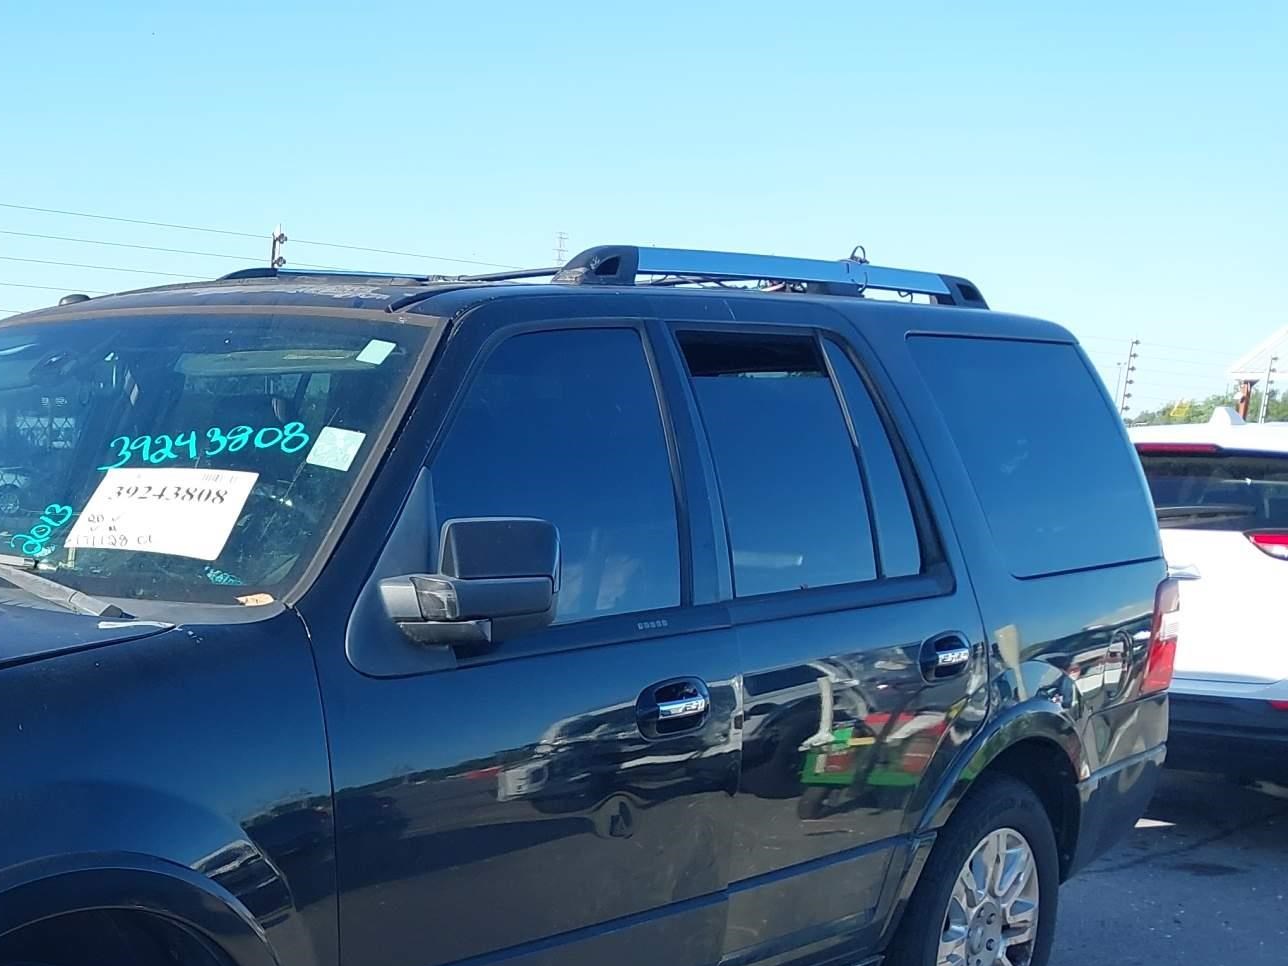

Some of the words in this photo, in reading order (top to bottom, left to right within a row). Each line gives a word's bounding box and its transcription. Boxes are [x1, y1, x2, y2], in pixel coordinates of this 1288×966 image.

[97, 420, 310, 471] 39243808
[108, 485, 229, 505] 39243808
[10, 503, 73, 555] 2013
